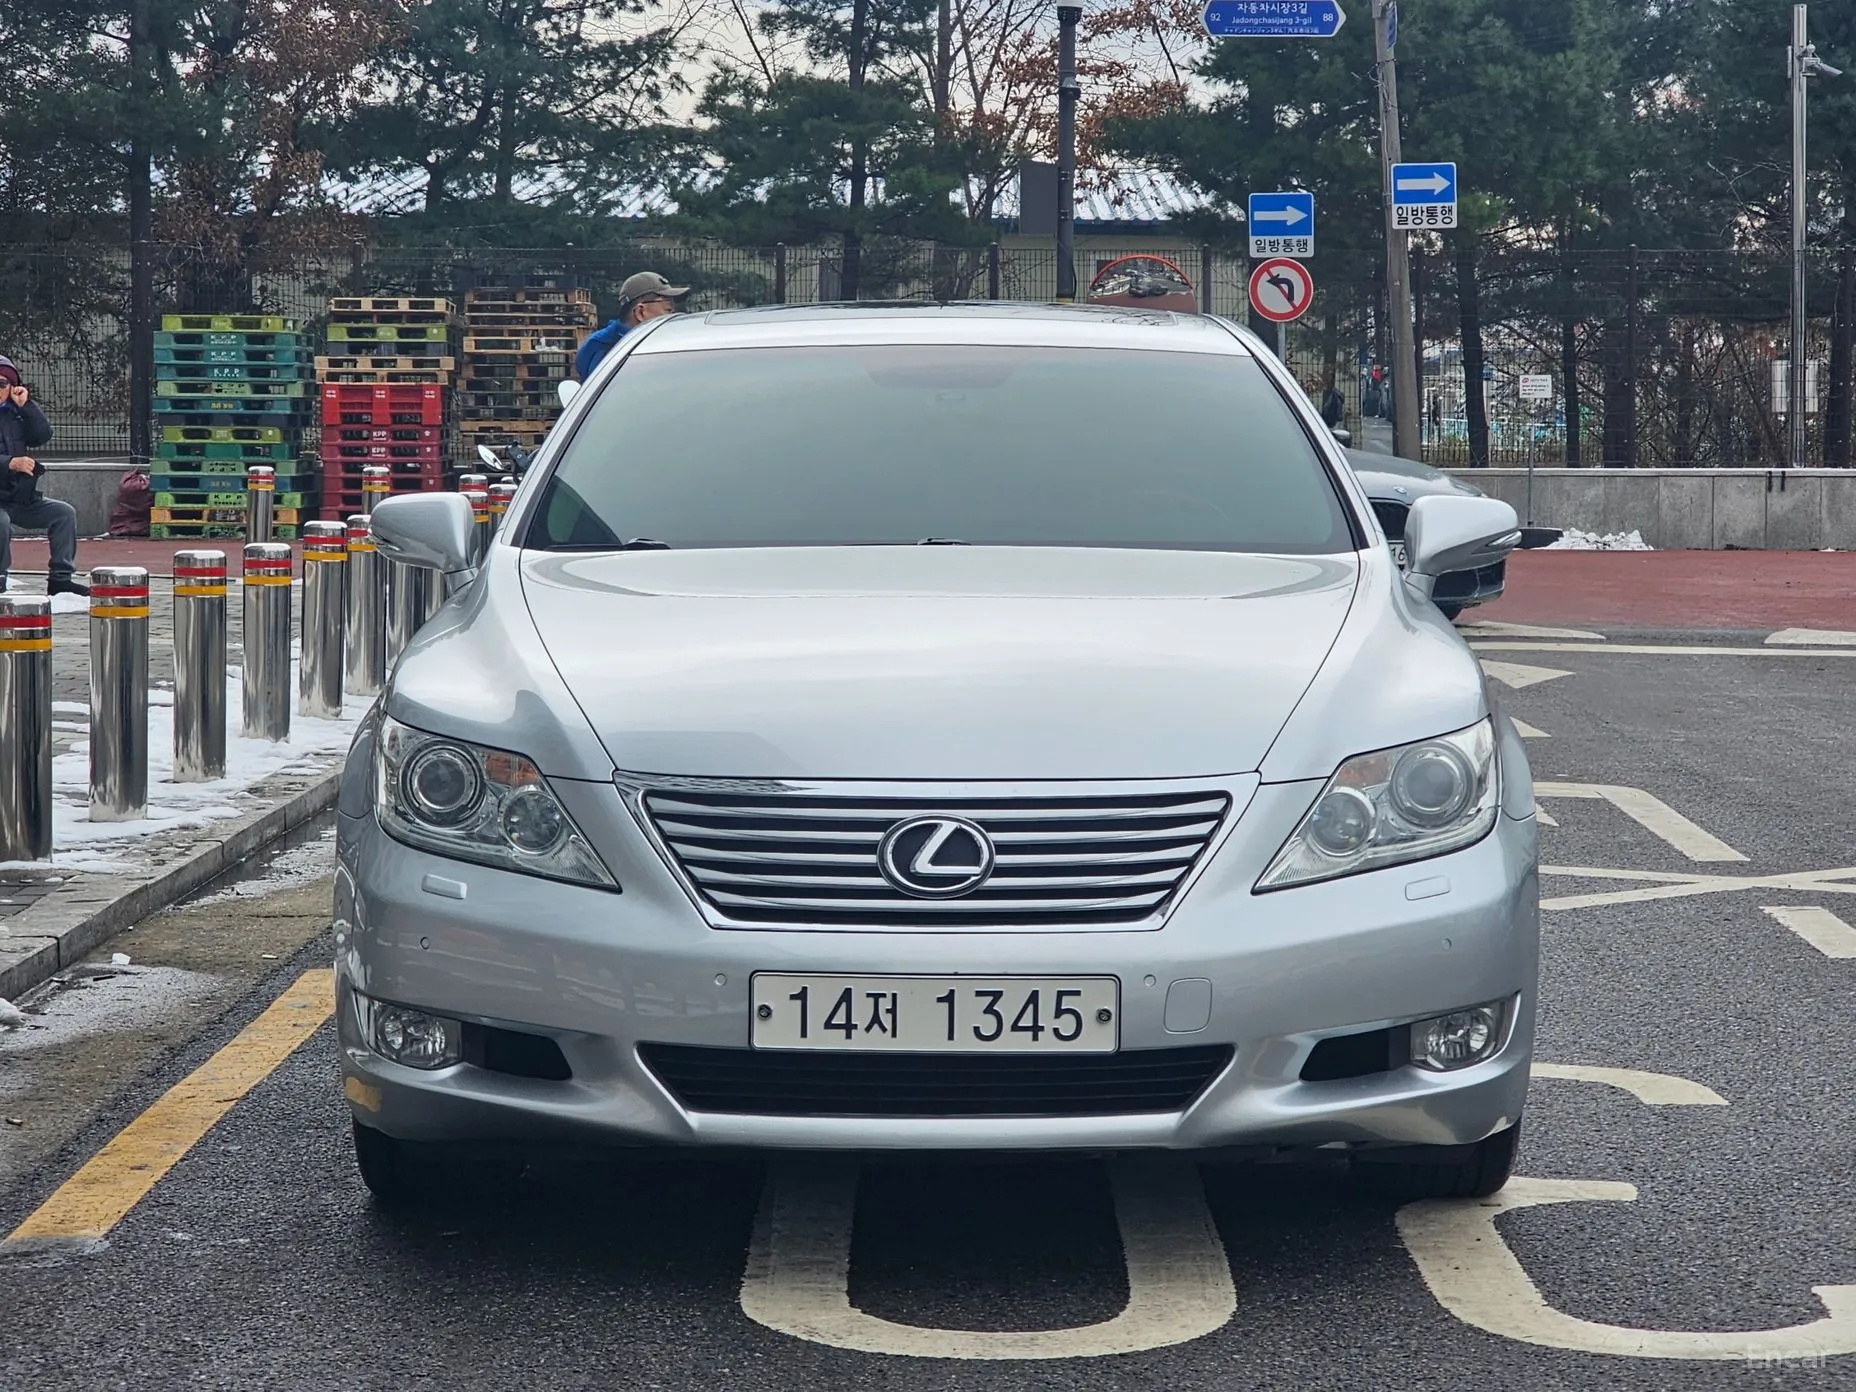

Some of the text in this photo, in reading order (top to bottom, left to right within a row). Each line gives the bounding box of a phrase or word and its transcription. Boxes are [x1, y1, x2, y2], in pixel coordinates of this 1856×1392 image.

[1237, 2, 1308, 14] 자동차시장3길
[1210, 13, 1221, 21] 92
[1232, 17, 1312, 25] Jadongchasijang 3-gil
[1322, 13, 1334, 21] 88
[1396, 205, 1453, 226] 일방통행
[1255, 238, 1308, 253] 일방통행
[789, 986, 1084, 1042] 14저 1345
